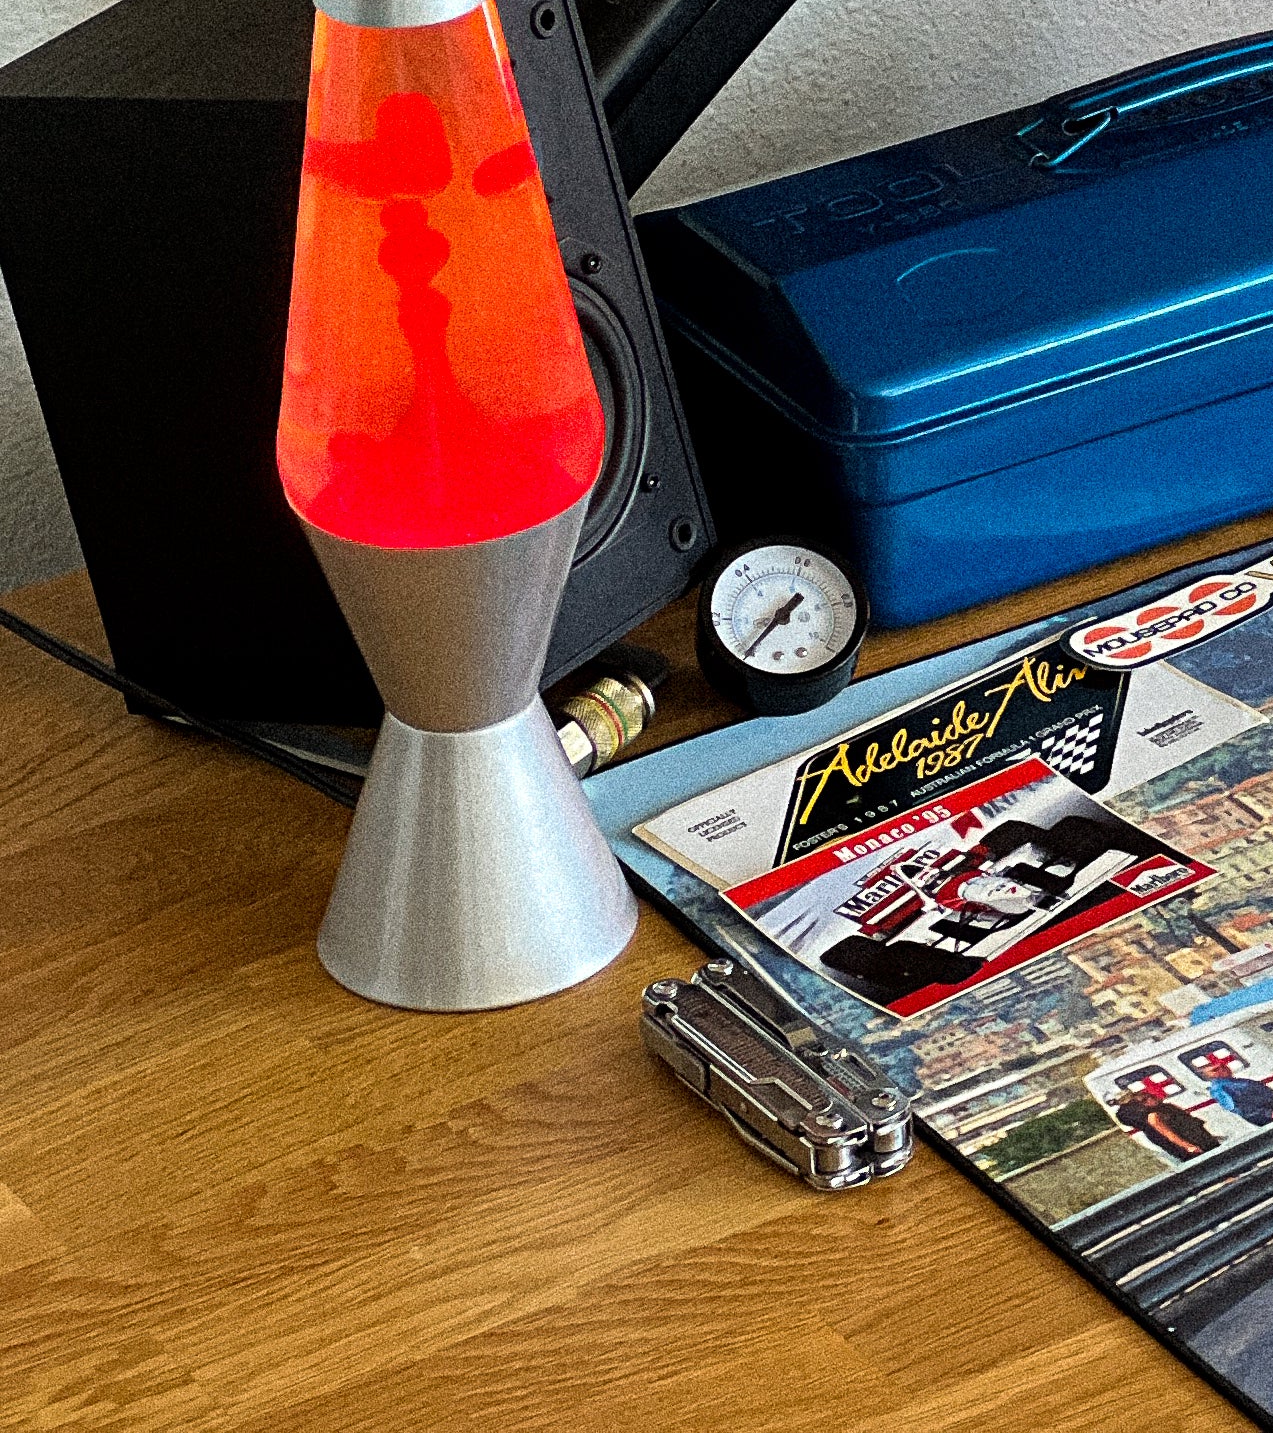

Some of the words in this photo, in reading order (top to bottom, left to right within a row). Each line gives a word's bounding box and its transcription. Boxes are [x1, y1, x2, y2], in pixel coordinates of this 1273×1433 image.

[1083, 599, 1218, 658] MOUSEPAD
[794, 700, 991, 826] Adelaide
[910, 764, 977, 798] AUSTRALIAN
[976, 739, 1029, 767] FORMULA
[916, 733, 985, 779] 1987
[832, 823, 916, 863] Monaco
[912, 804, 952, 825] '95
